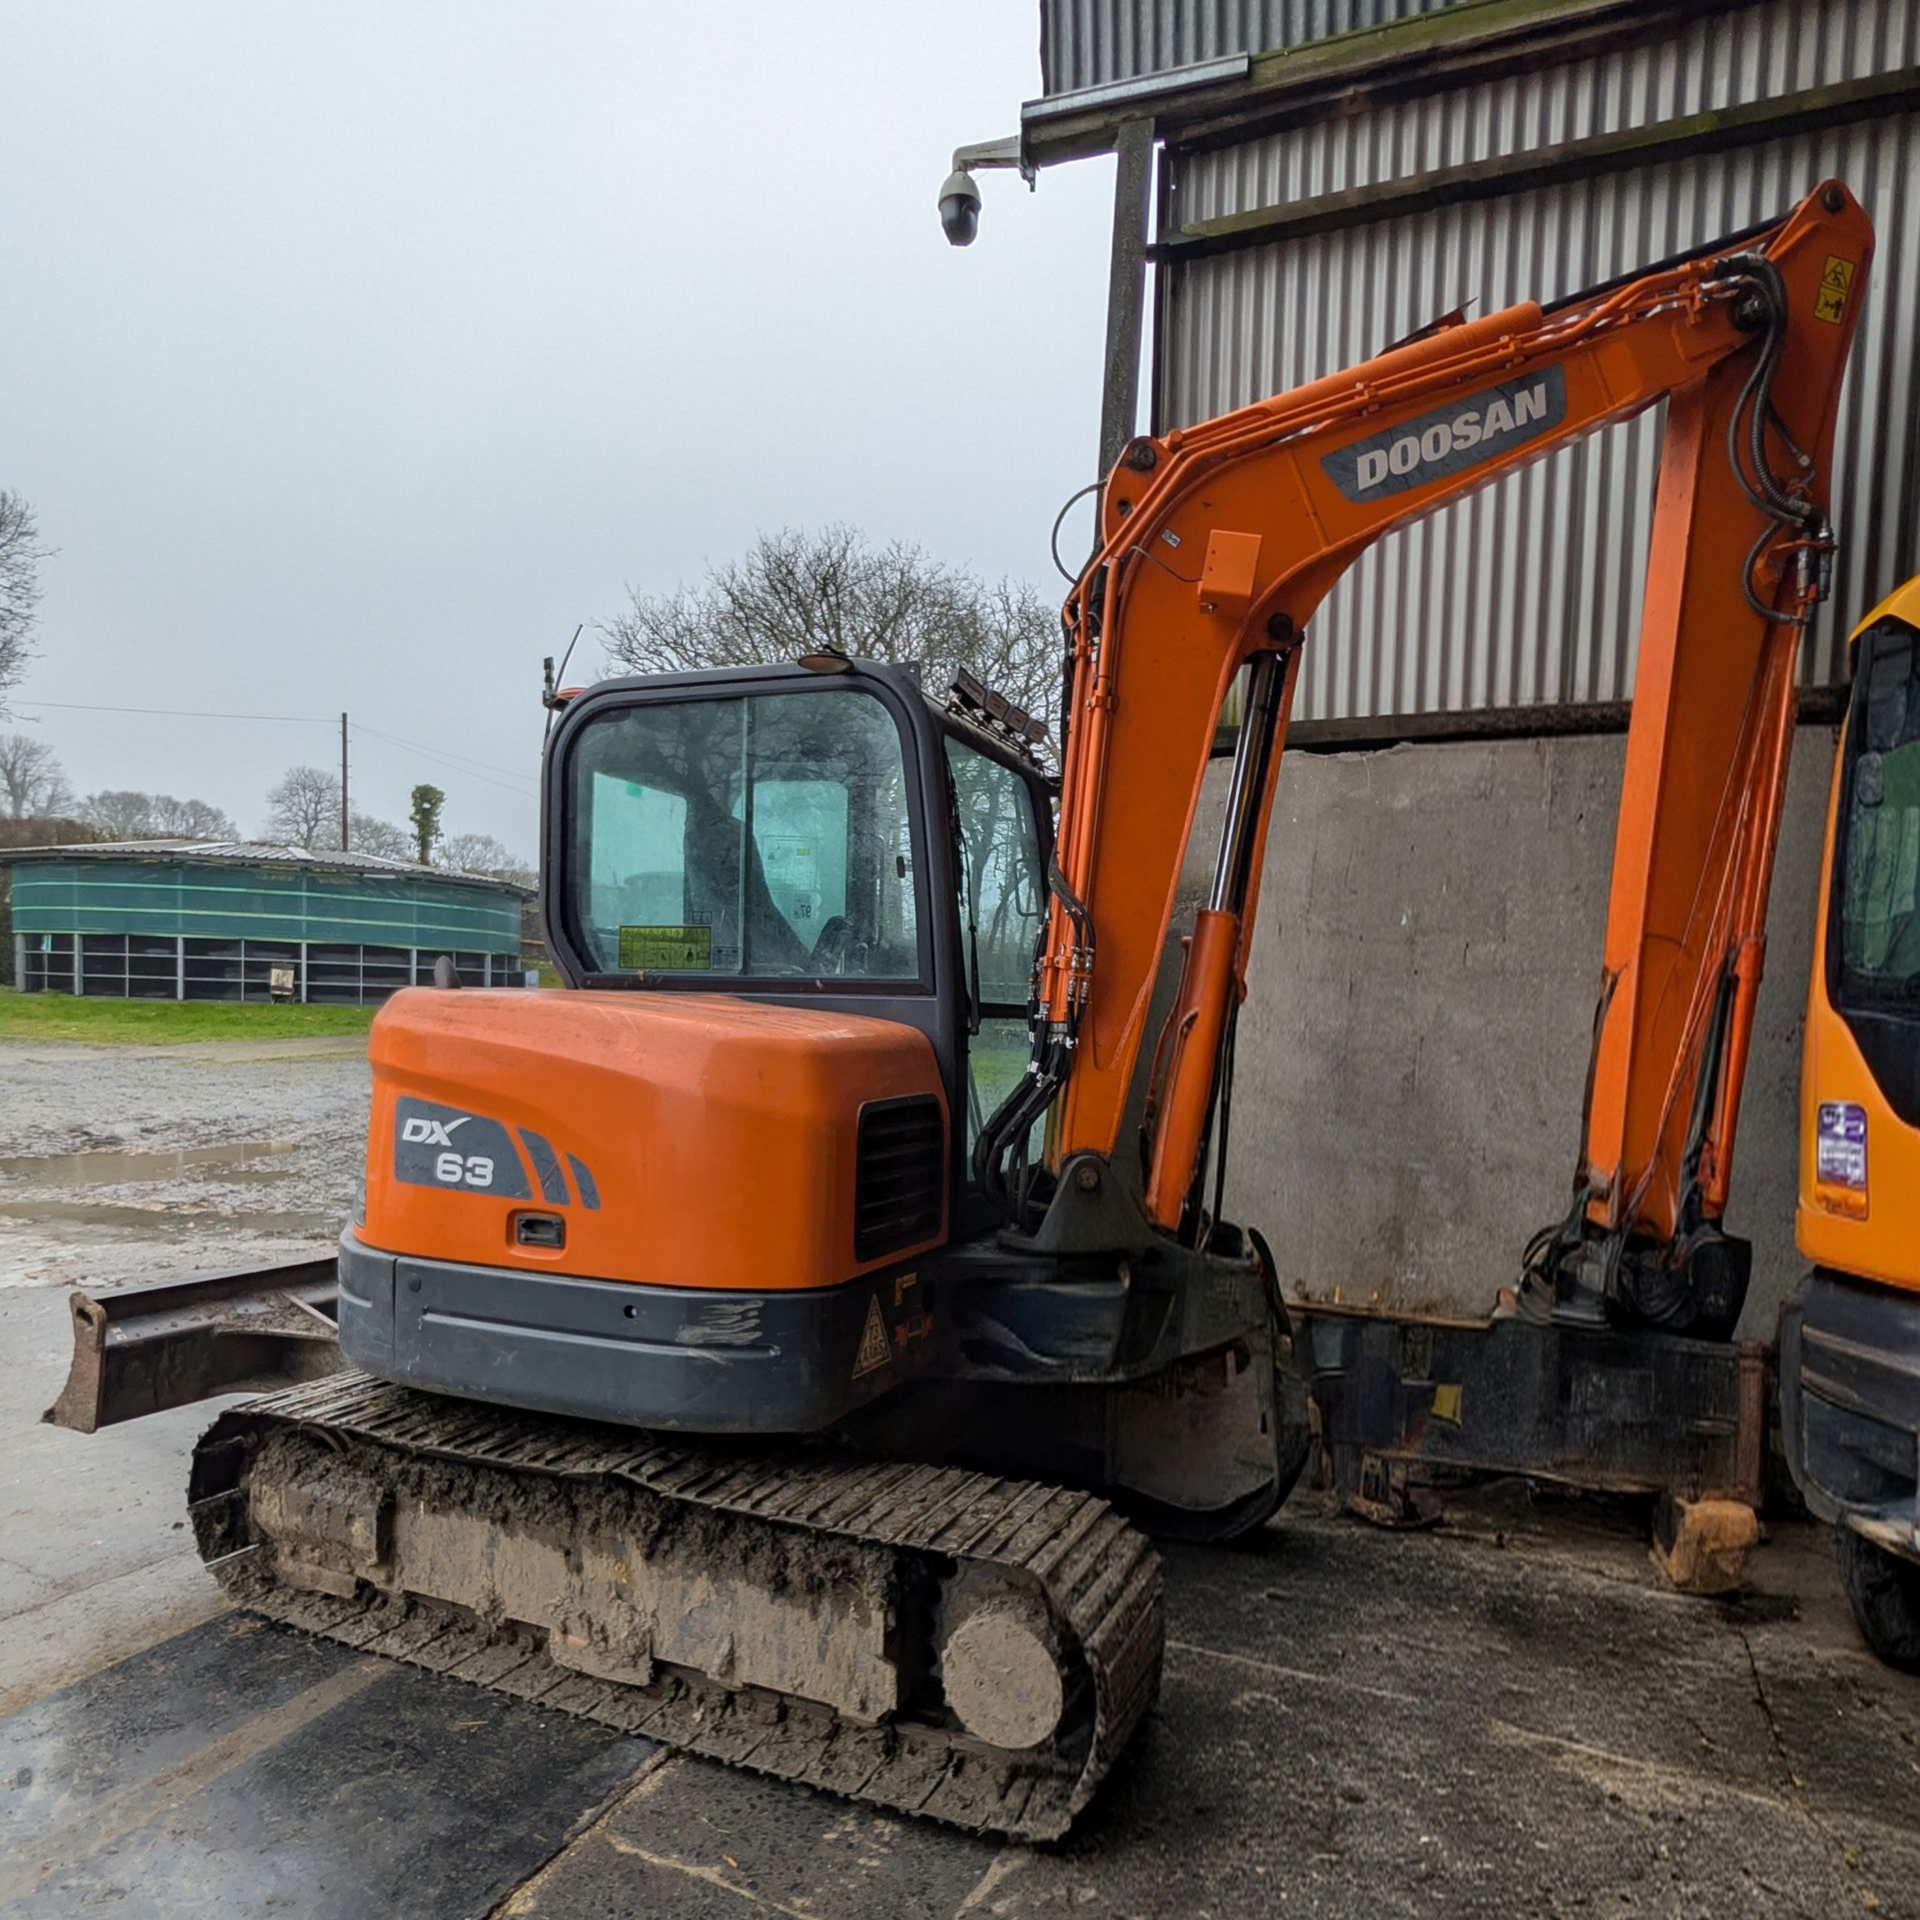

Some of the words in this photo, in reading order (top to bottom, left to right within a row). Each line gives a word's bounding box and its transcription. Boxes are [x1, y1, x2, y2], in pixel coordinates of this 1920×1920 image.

[1357, 383, 1547, 491] DOOSAN
[402, 1117, 472, 1147] DX
[436, 1152, 494, 1187] 63
